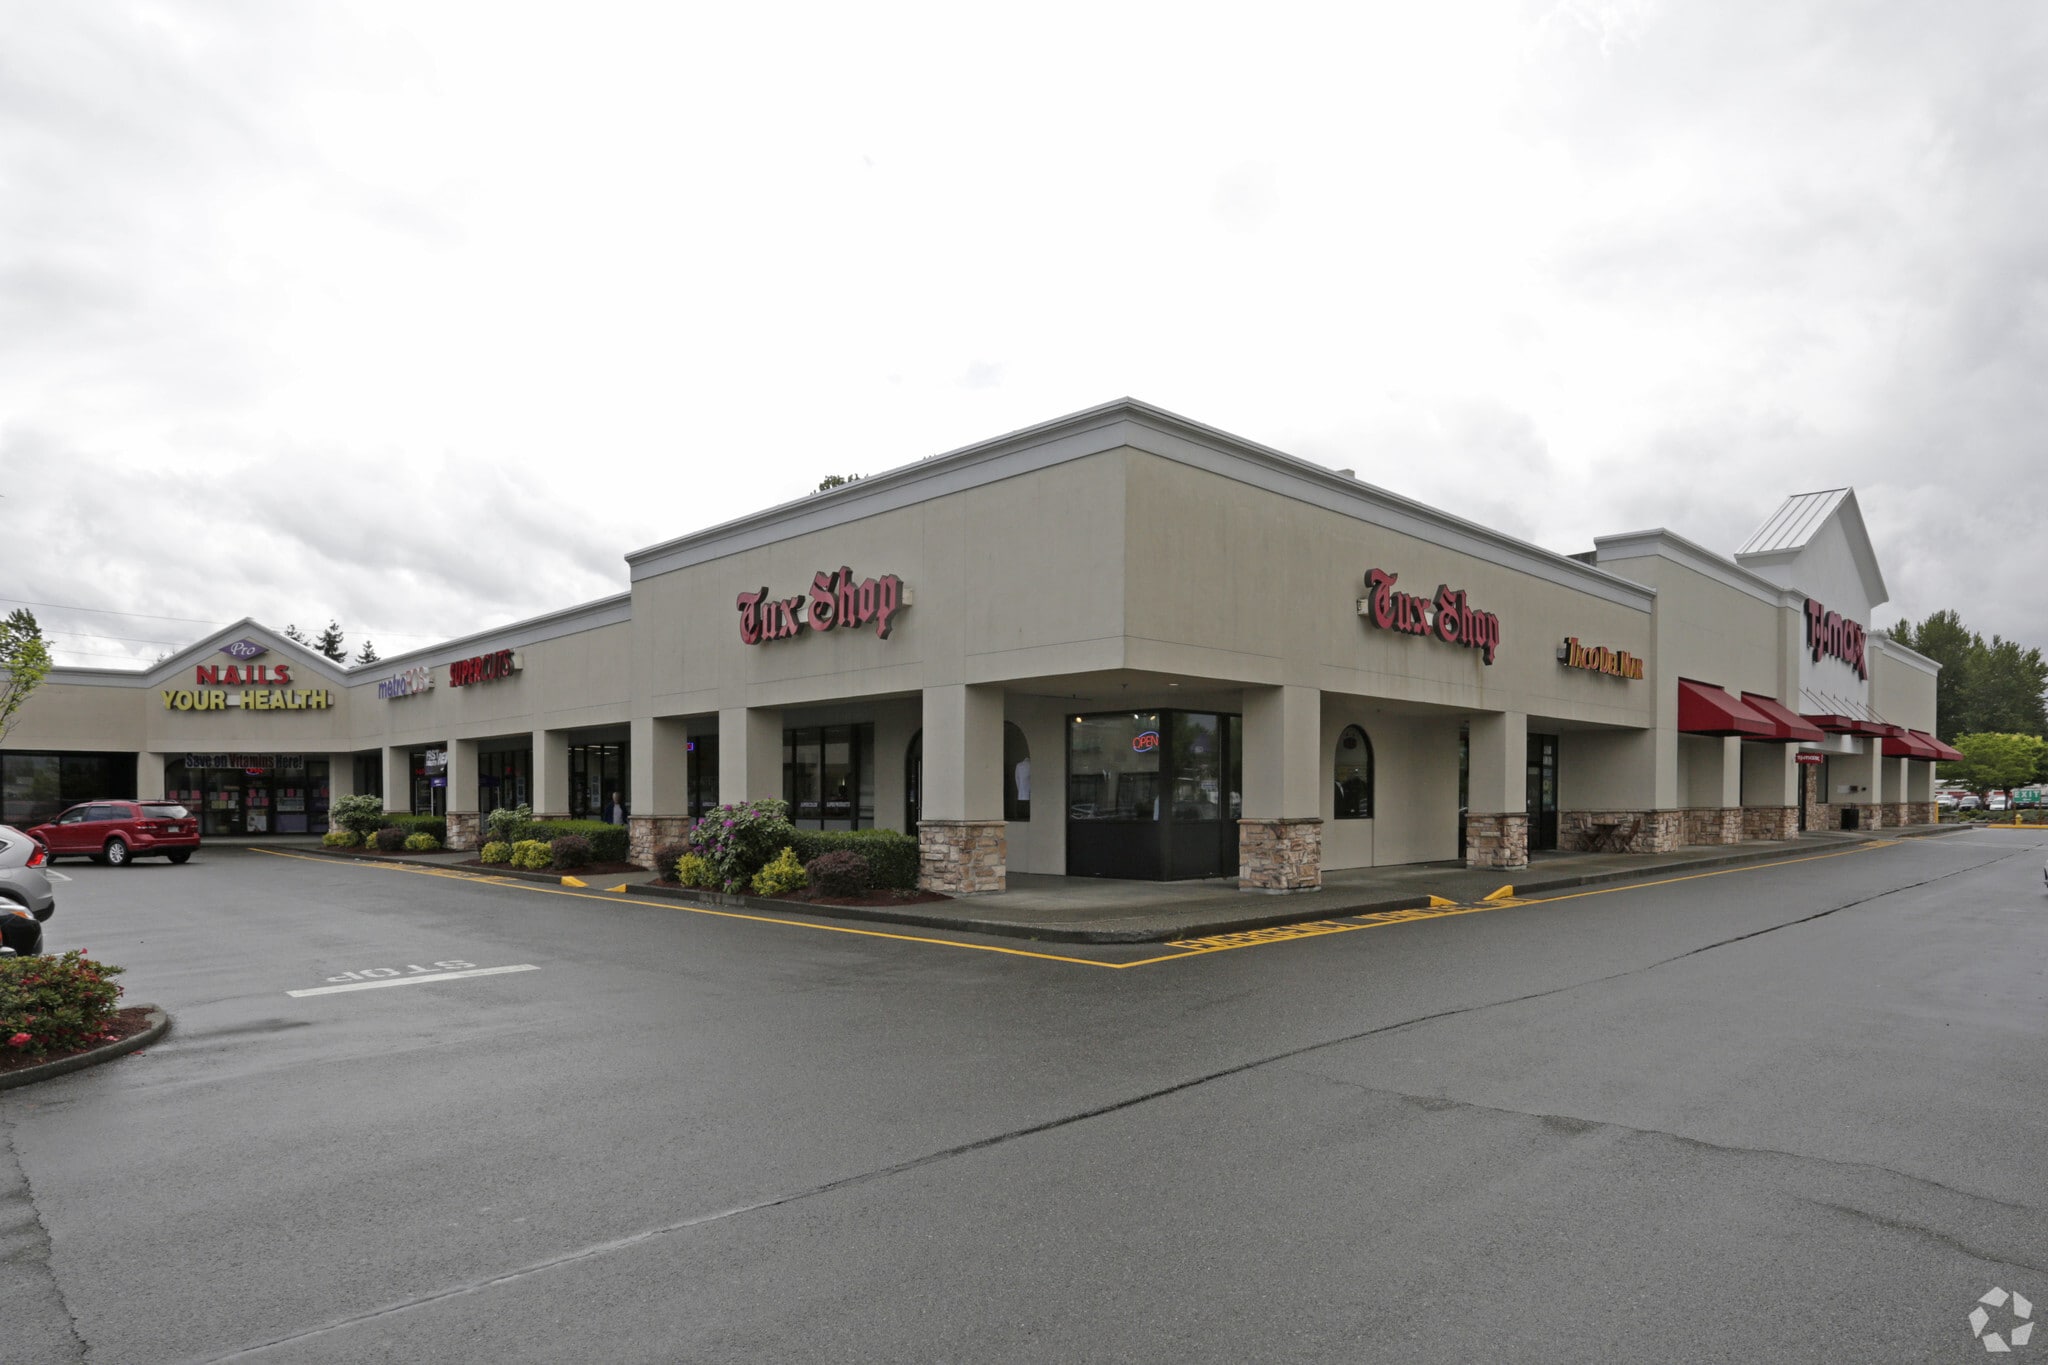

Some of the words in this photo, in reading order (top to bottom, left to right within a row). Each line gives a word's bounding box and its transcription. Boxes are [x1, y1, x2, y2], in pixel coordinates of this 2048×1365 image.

[737, 586, 805, 645] Tux
[808, 566, 903, 640] Shop
[1364, 568, 1432, 636] Tux
[1432, 584, 1499, 665] Shop
[231, 642, 256, 655] Pro
[196, 664, 290, 685] NAILS
[450, 649, 514, 687] SUPERCUTS
[160, 690, 226, 710] YOUR
[240, 689, 328, 709] HEALTH
[1132, 735, 1159, 749] OPEN
[186, 753, 212, 768] Save
[214, 755, 228, 768] on
[229, 753, 274, 768] Vitamins
[327, 960, 476, 983] STOP
